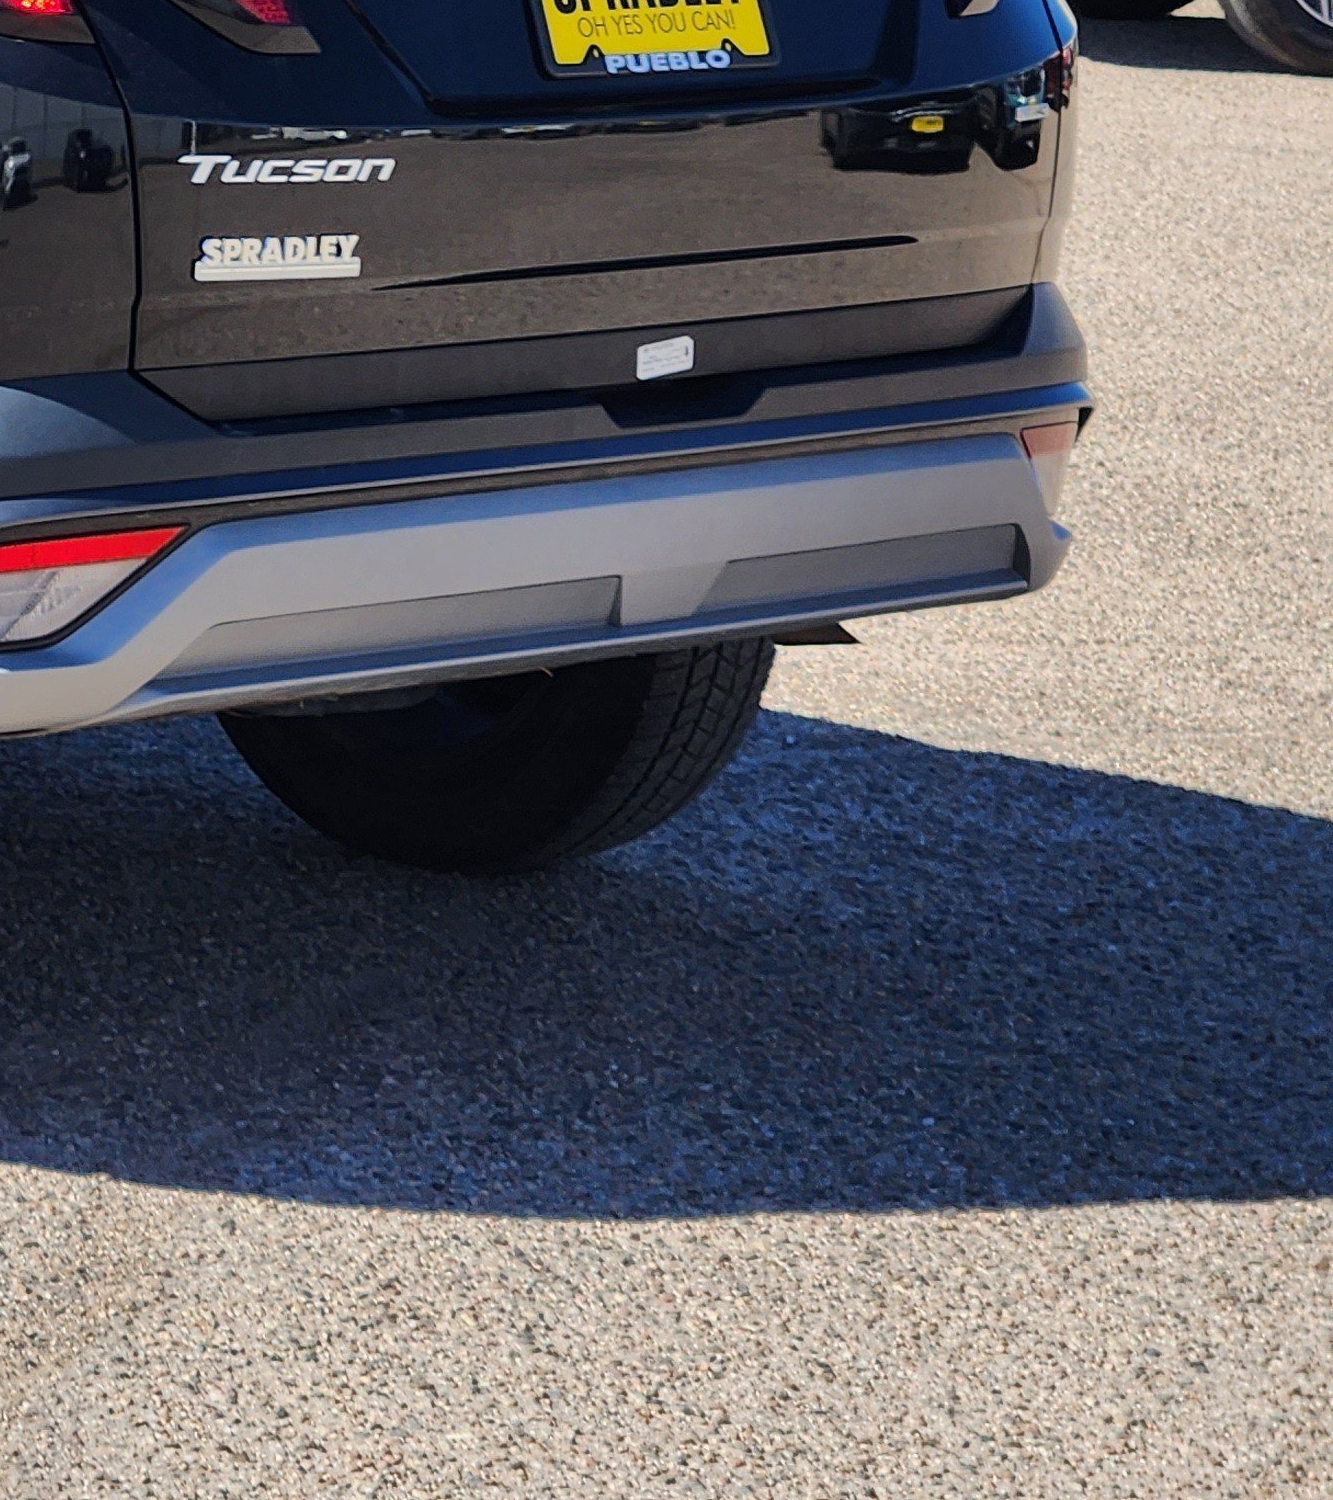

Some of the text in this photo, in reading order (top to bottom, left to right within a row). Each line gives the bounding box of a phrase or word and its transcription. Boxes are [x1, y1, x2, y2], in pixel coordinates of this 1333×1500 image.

[577, 8, 736, 38] OH YES YOU CAN!
[604, 49, 731, 75] PUEBLO
[200, 234, 360, 266] SPRADLEY
